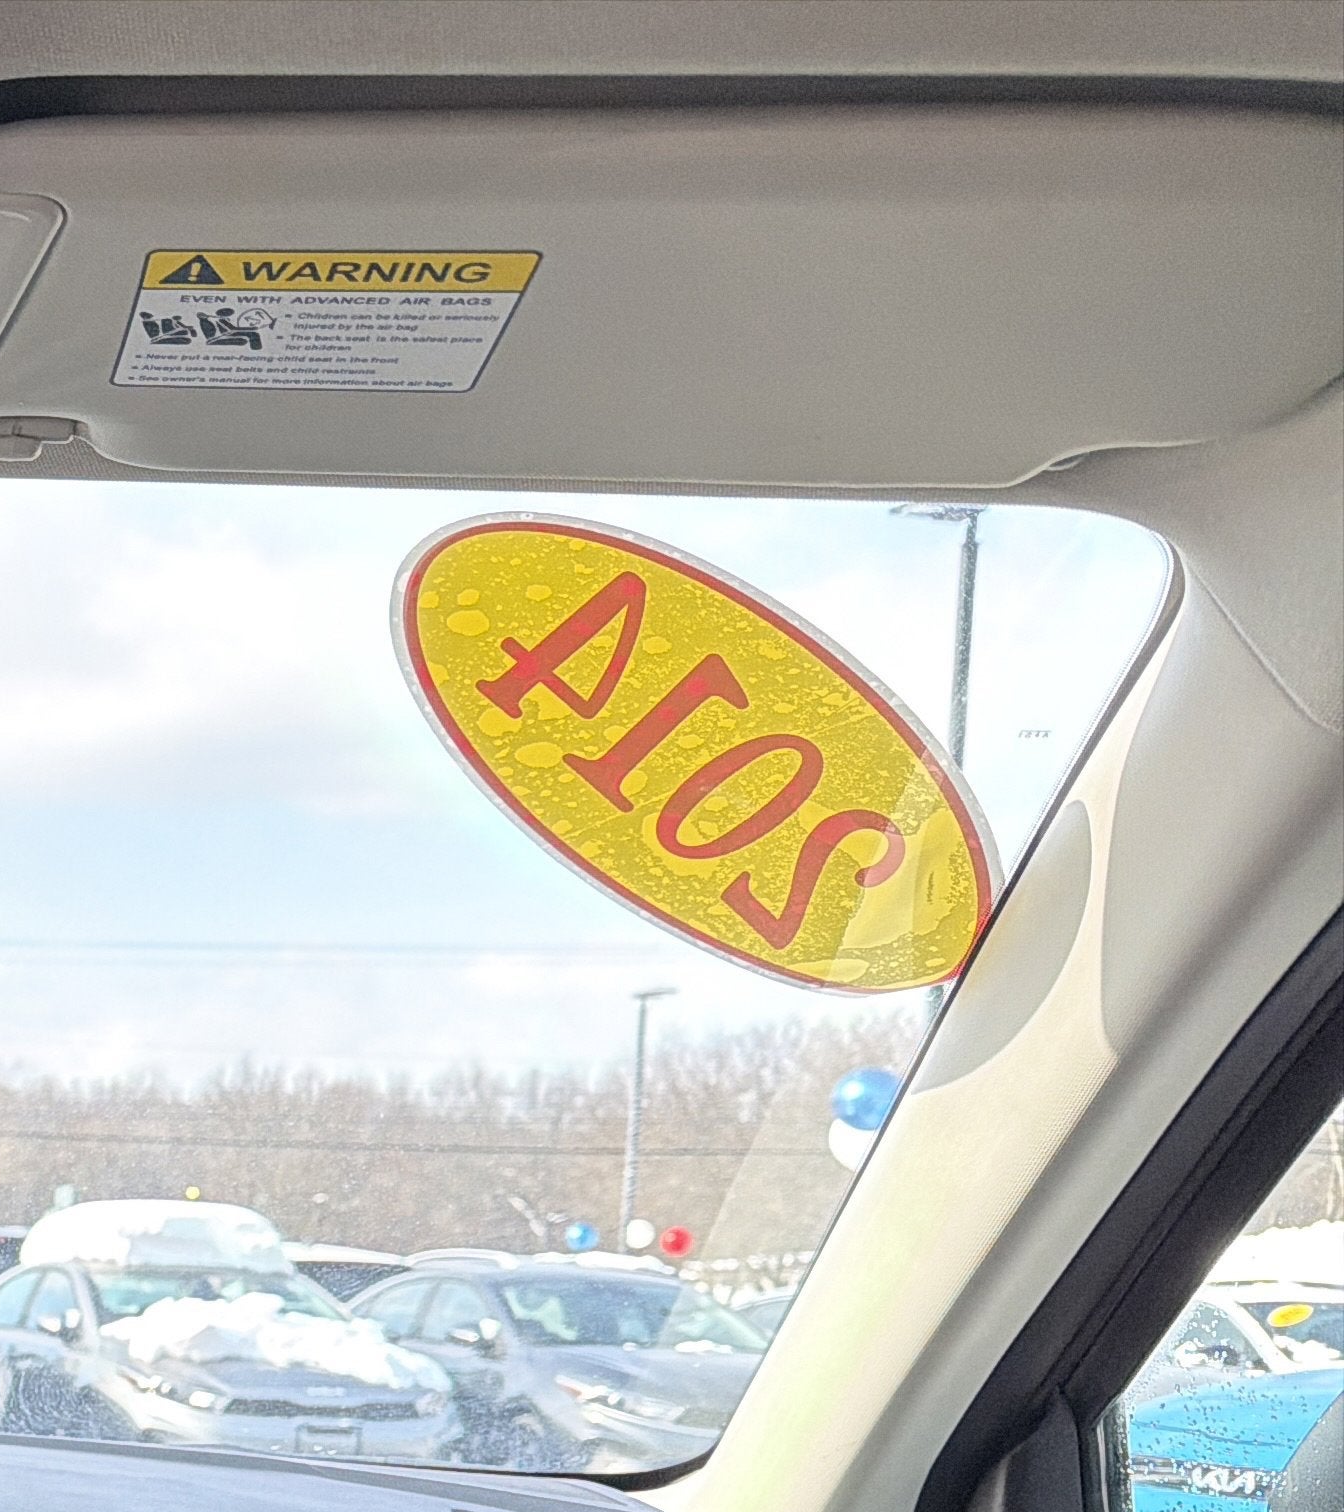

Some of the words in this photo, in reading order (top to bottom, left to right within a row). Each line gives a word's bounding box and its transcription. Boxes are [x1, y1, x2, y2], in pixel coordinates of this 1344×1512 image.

[242, 261, 492, 283] WARNING
[180, 295, 226, 303] EVEN
[238, 296, 281, 304] WITH
[290, 296, 390, 306] ADVANCED
[399, 297, 431, 305] AIR
[441, 297, 492, 306] BAGS
[298, 312, 347, 320] Children
[376, 313, 391, 321] be
[393, 313, 425, 321] killed
[445, 314, 500, 322] seriously
[338, 323, 351, 331] by
[396, 324, 418, 332] bag
